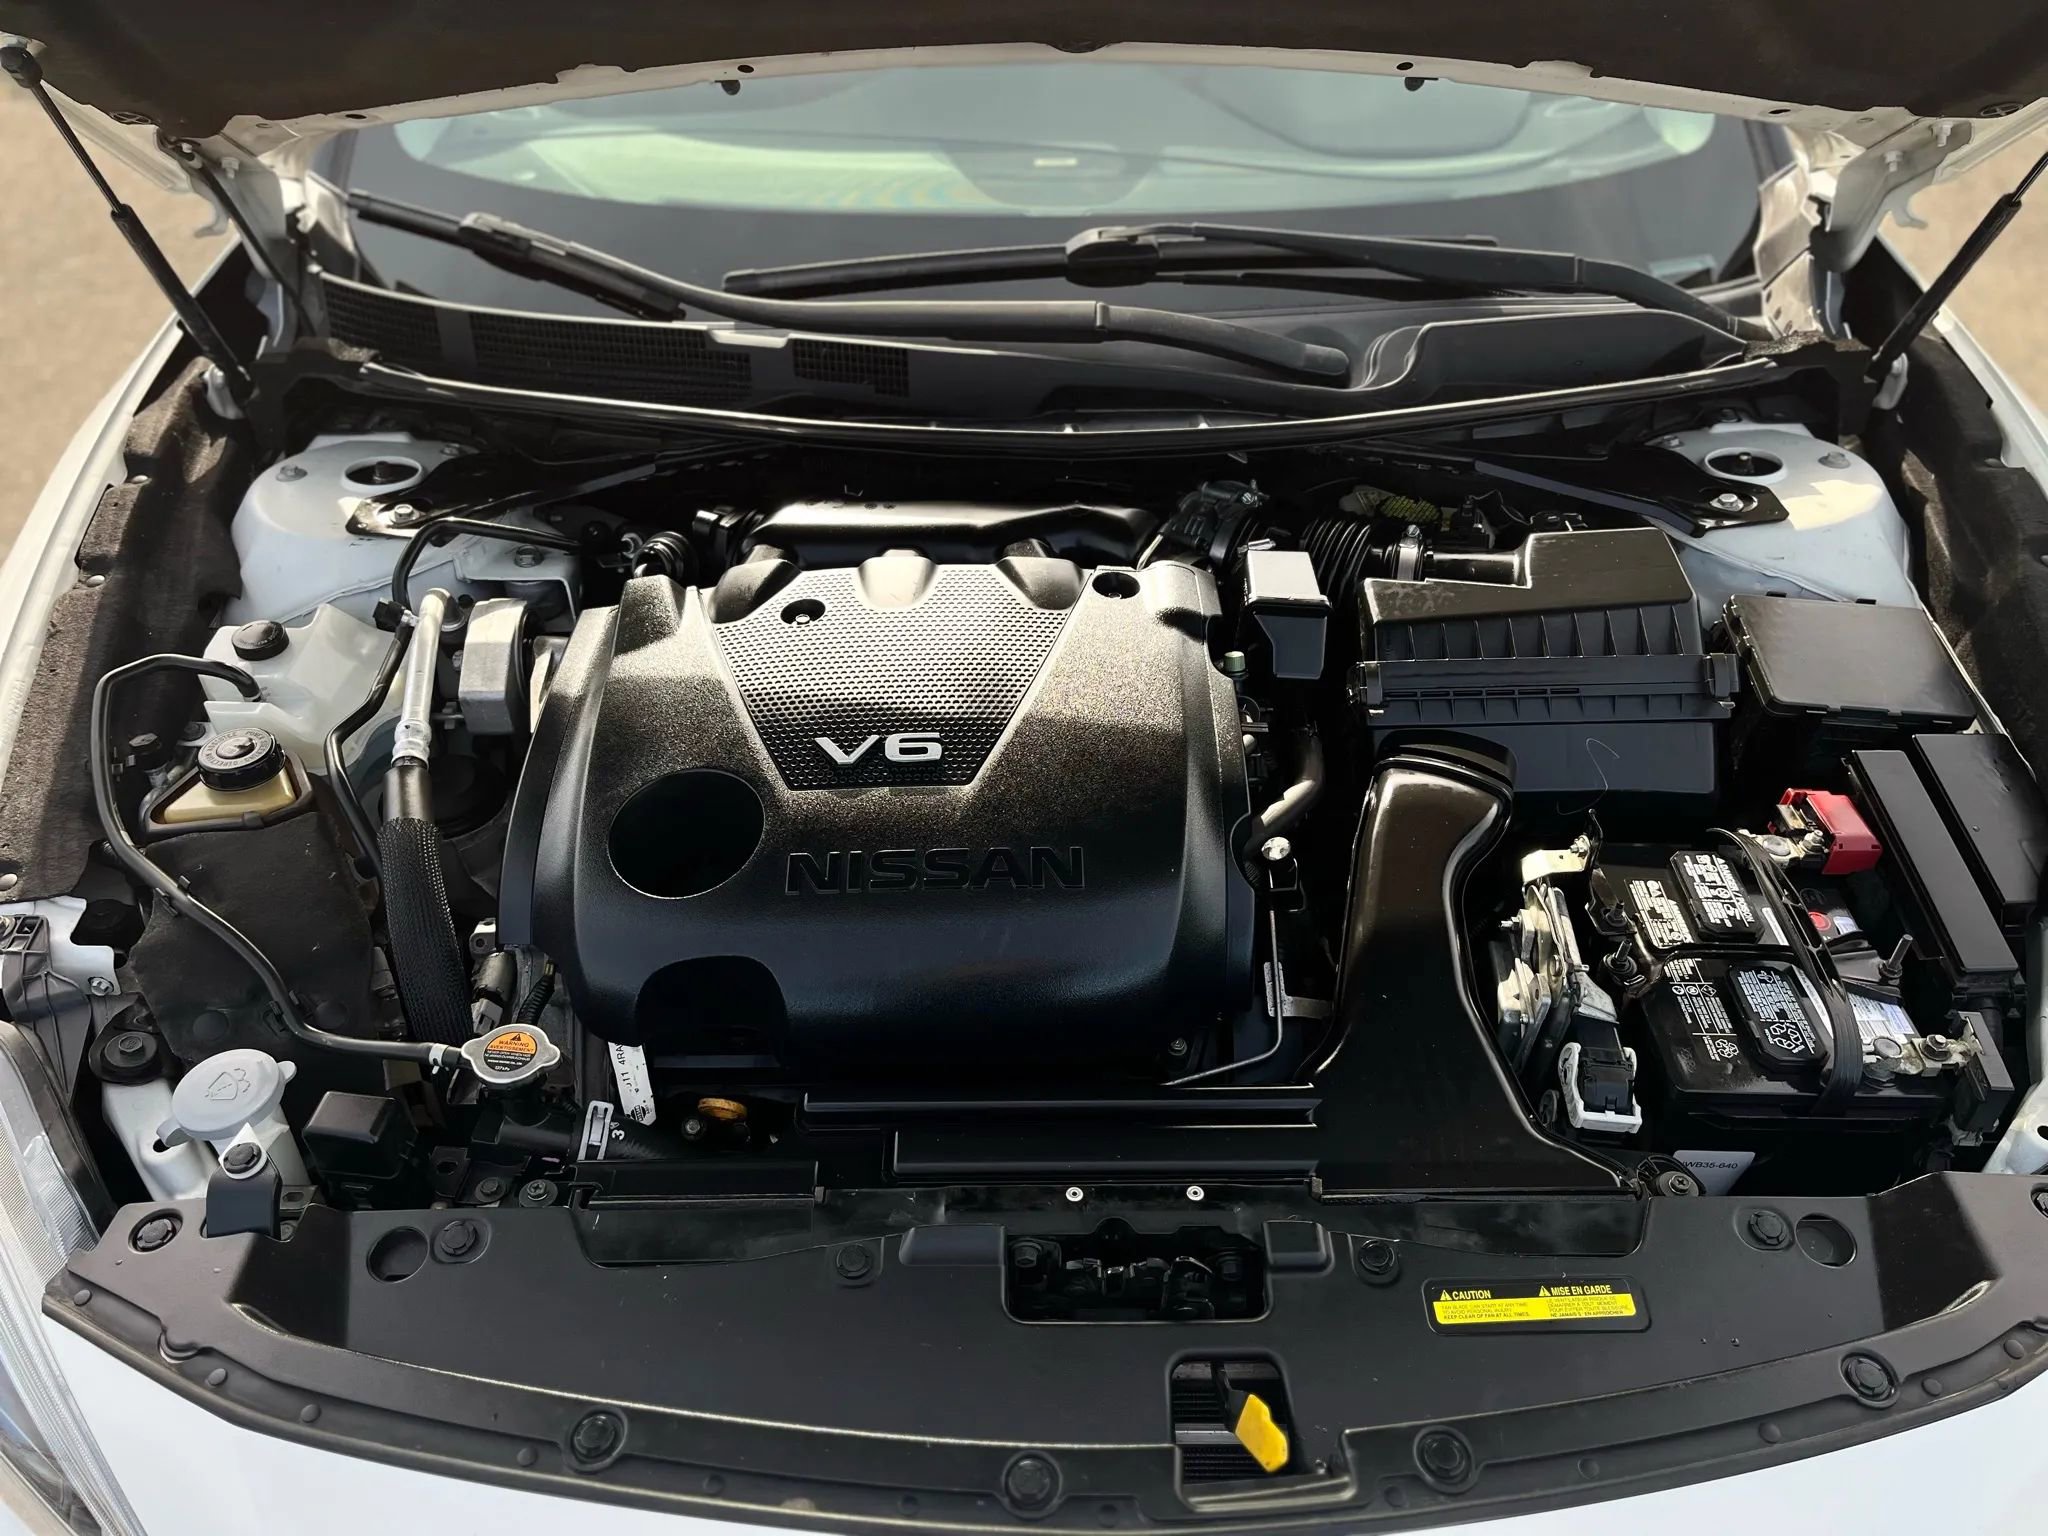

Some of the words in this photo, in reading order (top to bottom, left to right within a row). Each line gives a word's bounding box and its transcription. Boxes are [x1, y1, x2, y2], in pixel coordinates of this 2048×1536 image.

[814, 732, 943, 765] V6
[785, 846, 1086, 896] NISSAN
[499, 1040, 530, 1048] WARNING
[1452, 1290, 1492, 1300] CAUTION
[1550, 1286, 1571, 1296] MISE
[1571, 1286, 1584, 1295] EN
[1584, 1284, 1612, 1295] GARDE
